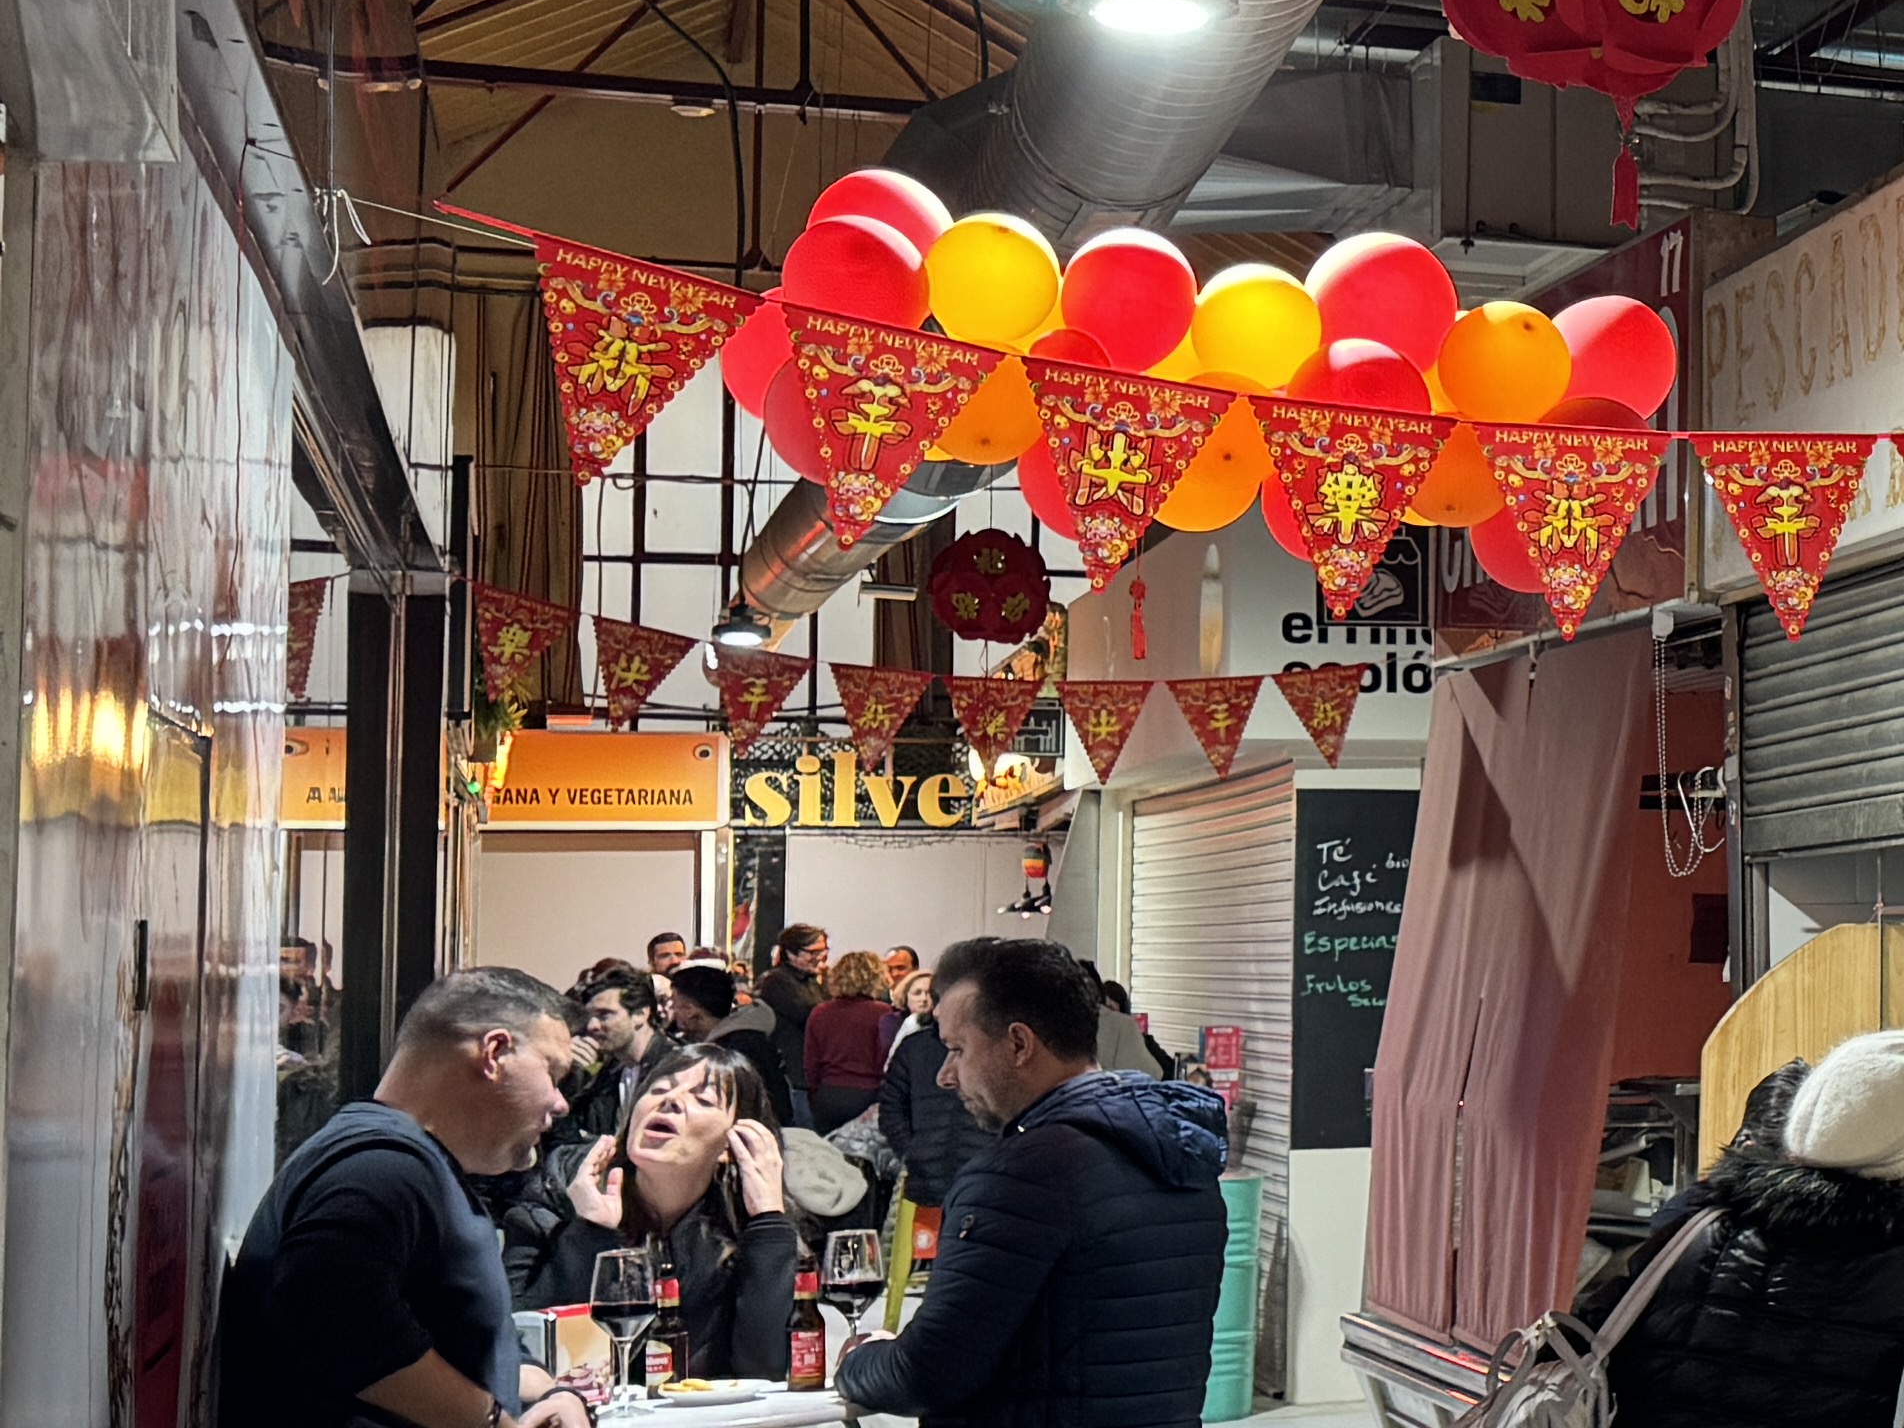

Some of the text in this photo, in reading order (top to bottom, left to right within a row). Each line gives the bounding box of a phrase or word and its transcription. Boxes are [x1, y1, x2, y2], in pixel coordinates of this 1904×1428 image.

[555, 248, 736, 309] HAPPY NEW YEAR
[806, 315, 979, 366] HAPPY NEW YEAR
[1044, 368, 1211, 409] HAPPY NEW YEAR
[1272, 404, 1433, 435] HAPPY NEW YEAR
[1495, 429, 1649, 451] HAPPY NEW YEAR
[1712, 439, 1857, 455] HAPPY NEW YEAR
[547, 788, 562, 806] Y
[567, 787, 694, 806] VEGETARIANA
[1316, 838, 1352, 864] Té
[1317, 864, 1379, 896] Café
[1301, 974, 1372, 996] Frutos
